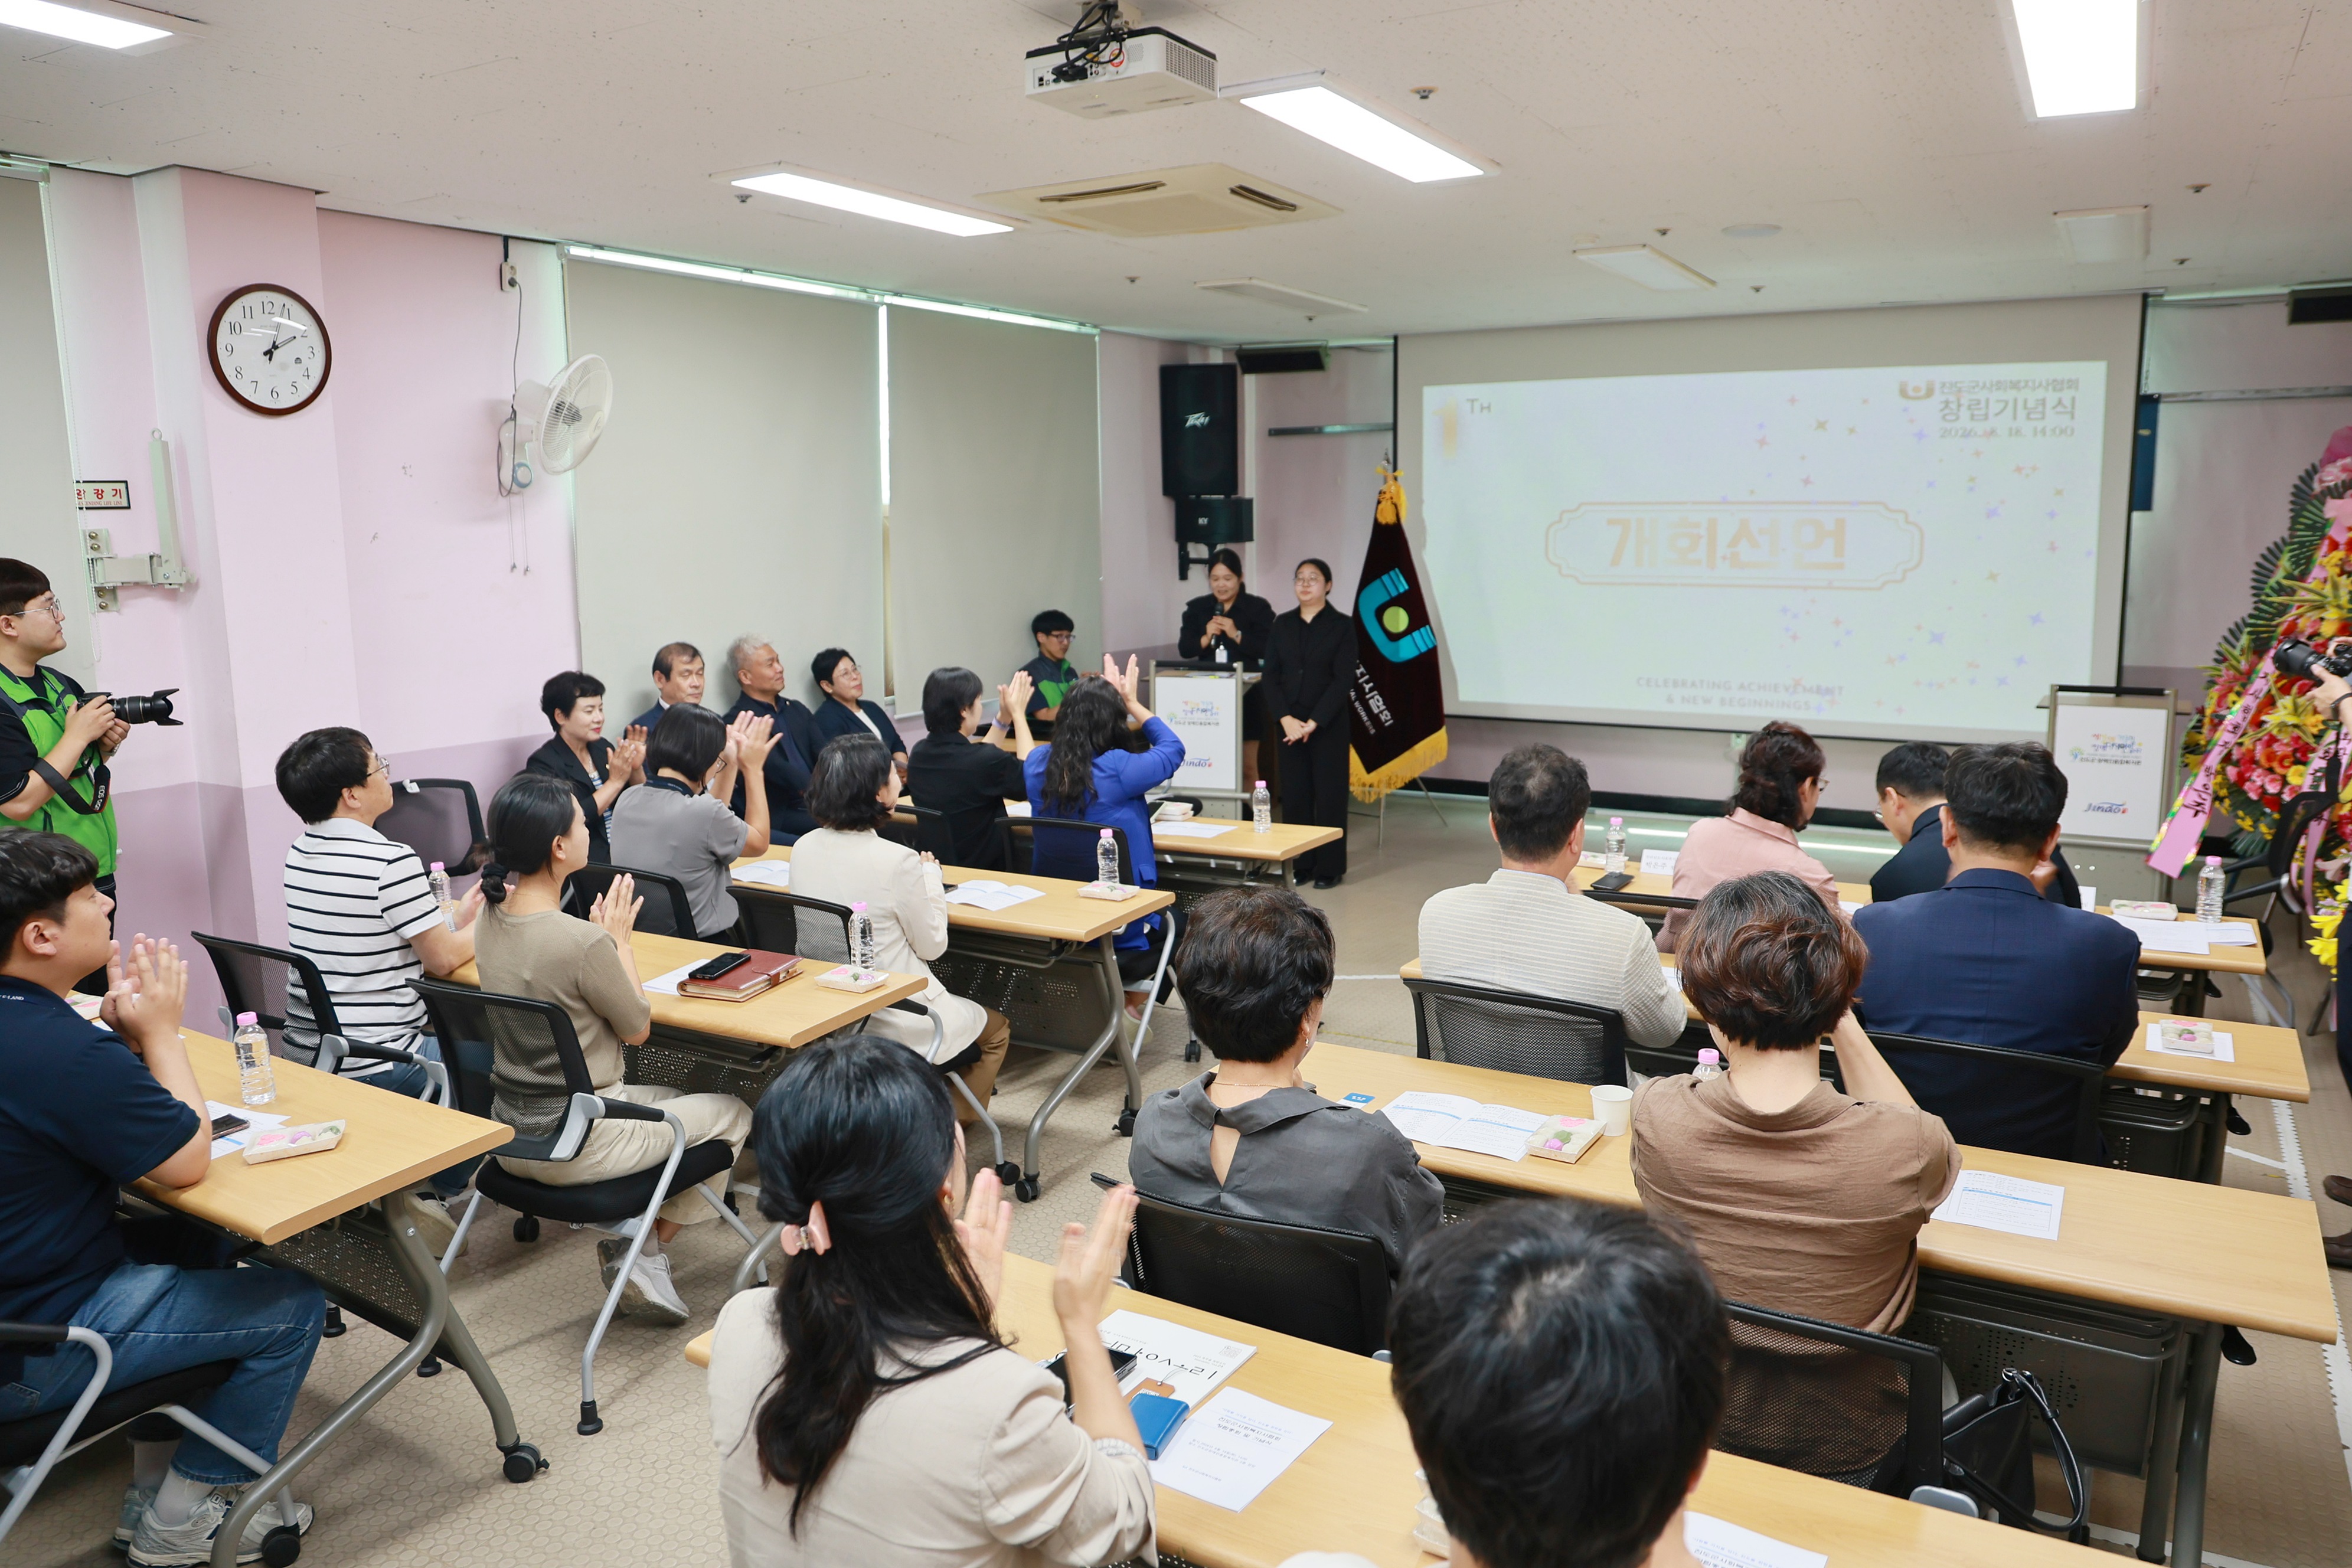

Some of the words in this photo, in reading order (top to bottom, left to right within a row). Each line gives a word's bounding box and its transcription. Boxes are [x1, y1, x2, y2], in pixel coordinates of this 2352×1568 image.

[242, 305, 253, 319] 11
[261, 301, 275, 315] 12
[229, 321, 241, 335] 10
[225, 342, 233, 357] 9
[308, 346, 315, 360] 3
[235, 366, 243, 380] 8
[302, 367, 311, 380] 4
[250, 381, 258, 394] 7
[270, 386, 279, 399] 6
[290, 381, 298, 394] 5
[1939, 377, 2080, 394] 진도군사회복지사협회
[1939, 395, 2077, 422] 창립기념식
[1605, 516, 1848, 571] 개회선언
[1636, 677, 1732, 691] CELEBRATING
[1738, 681, 1845, 697] ACHIEVEMENT
[1681, 694, 1713, 705] NEW
[1720, 697, 1812, 711] BEGINNINGS
[1354, 700, 1376, 734] WORKERS
[2083, 803, 2121, 814] Jindo
